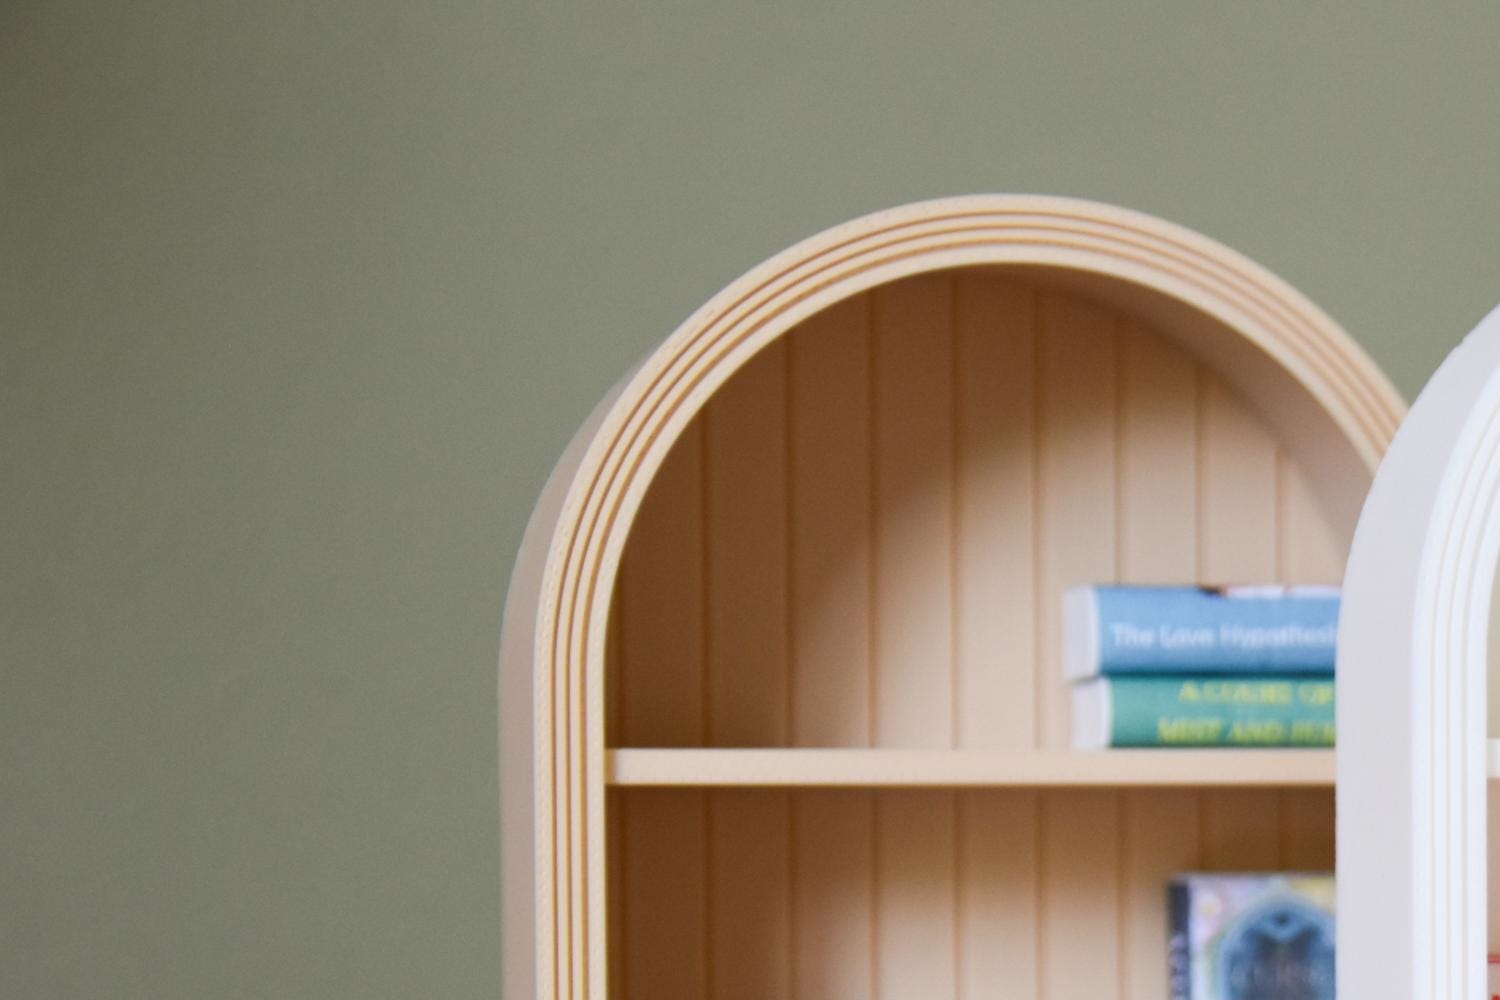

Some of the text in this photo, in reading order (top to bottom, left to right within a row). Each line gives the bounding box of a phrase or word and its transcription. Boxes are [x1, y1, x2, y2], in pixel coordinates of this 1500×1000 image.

[1112, 622, 1338, 652] The Love Hypothesi
[1179, 681, 1199, 704] A
